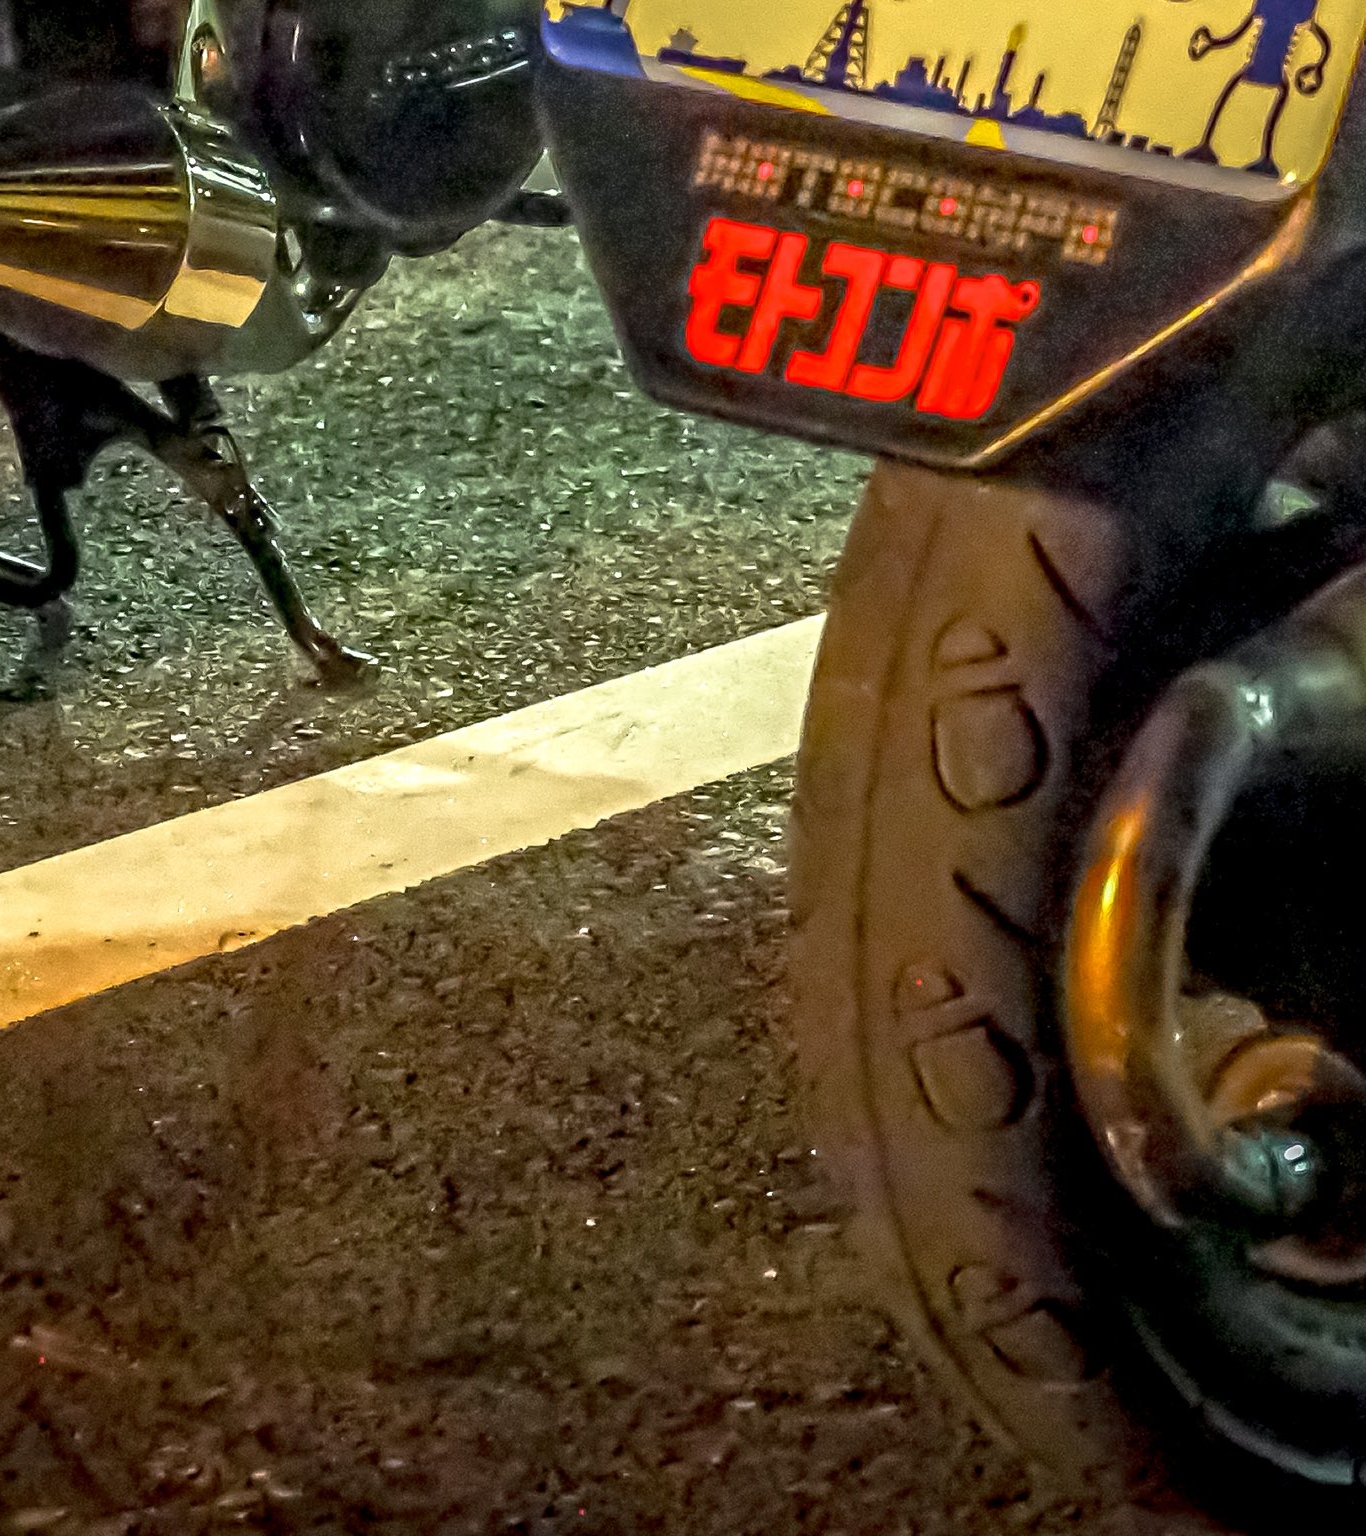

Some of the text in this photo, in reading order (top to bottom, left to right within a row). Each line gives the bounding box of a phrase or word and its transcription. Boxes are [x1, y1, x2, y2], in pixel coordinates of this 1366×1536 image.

[685, 217, 1040, 420] モトコンポ
